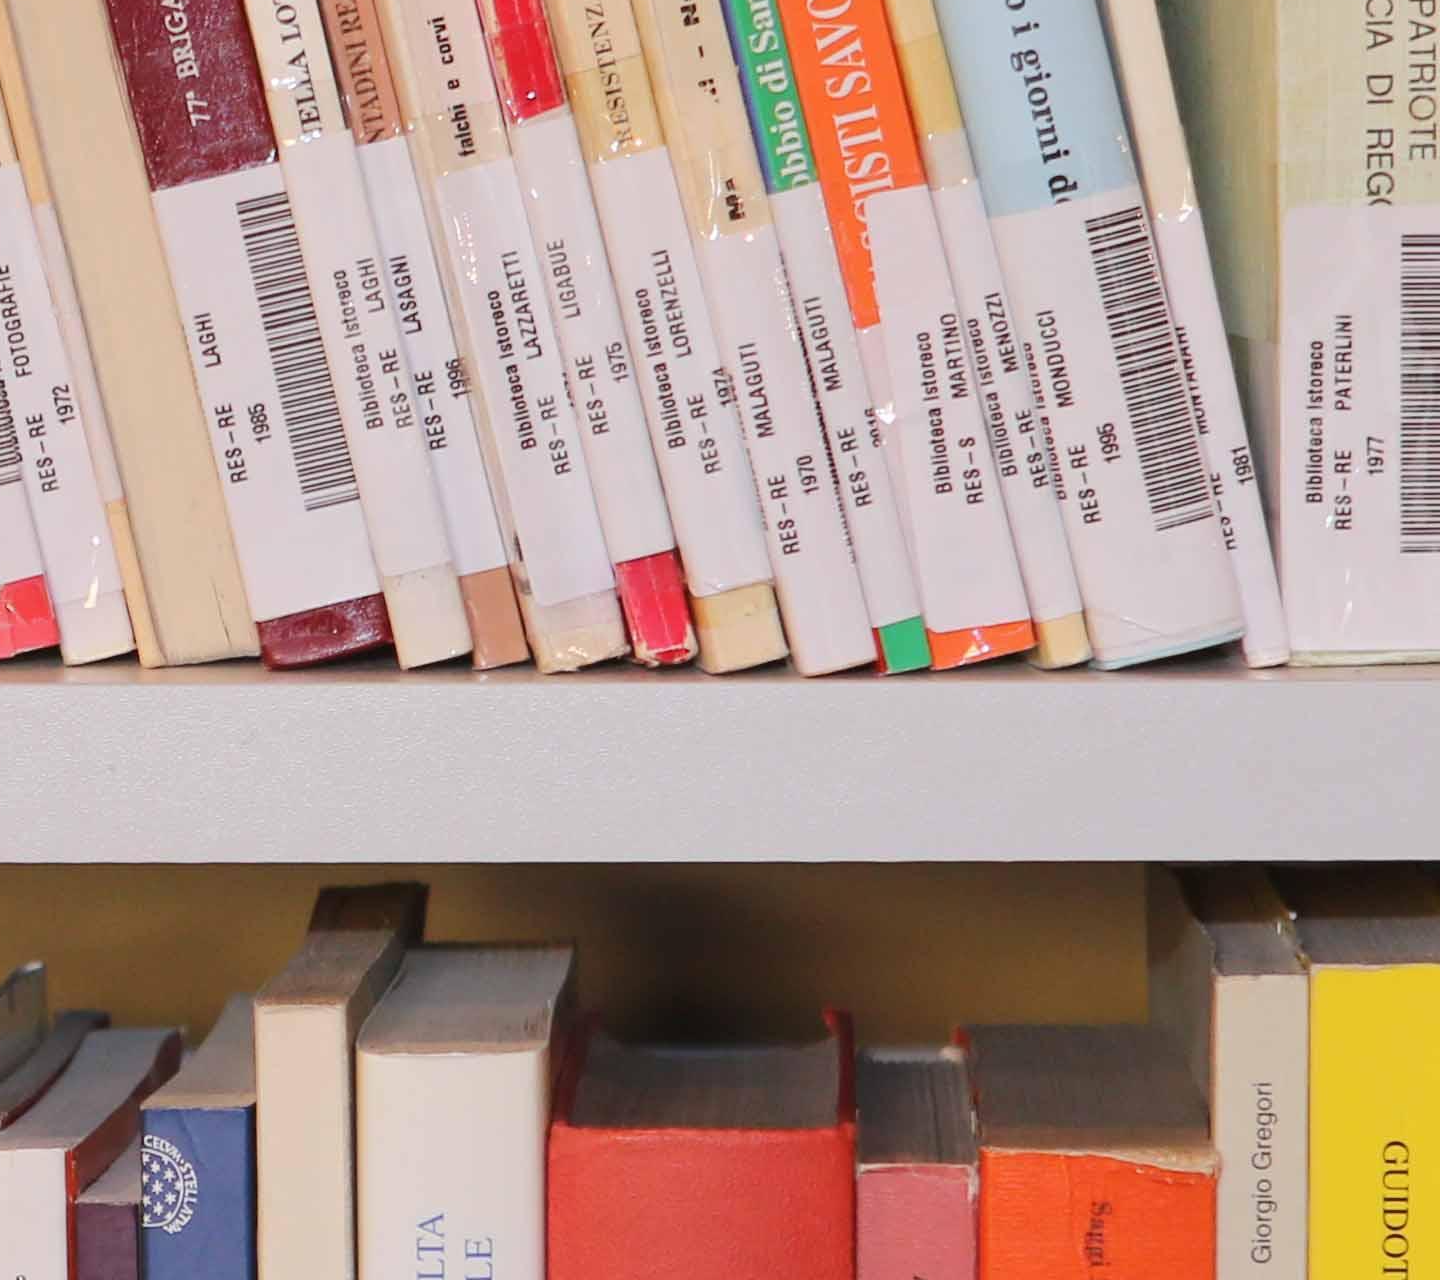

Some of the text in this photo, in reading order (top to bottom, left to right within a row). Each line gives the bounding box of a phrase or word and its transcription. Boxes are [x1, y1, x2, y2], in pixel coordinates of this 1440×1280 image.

[1011, 47, 1069, 167] giorni
[1364, 73, 1395, 107] DI
[388, 254, 421, 335] LASAGNI
[501, 250, 542, 360] LAZZARETTI
[1036, 309, 1074, 409] MONDUCCI
[1334, 314, 1353, 412] PATERLINI
[1305, 340, 1325, 503] Biblioteca Istoreco
[1366, 436, 1385, 476] 1977
